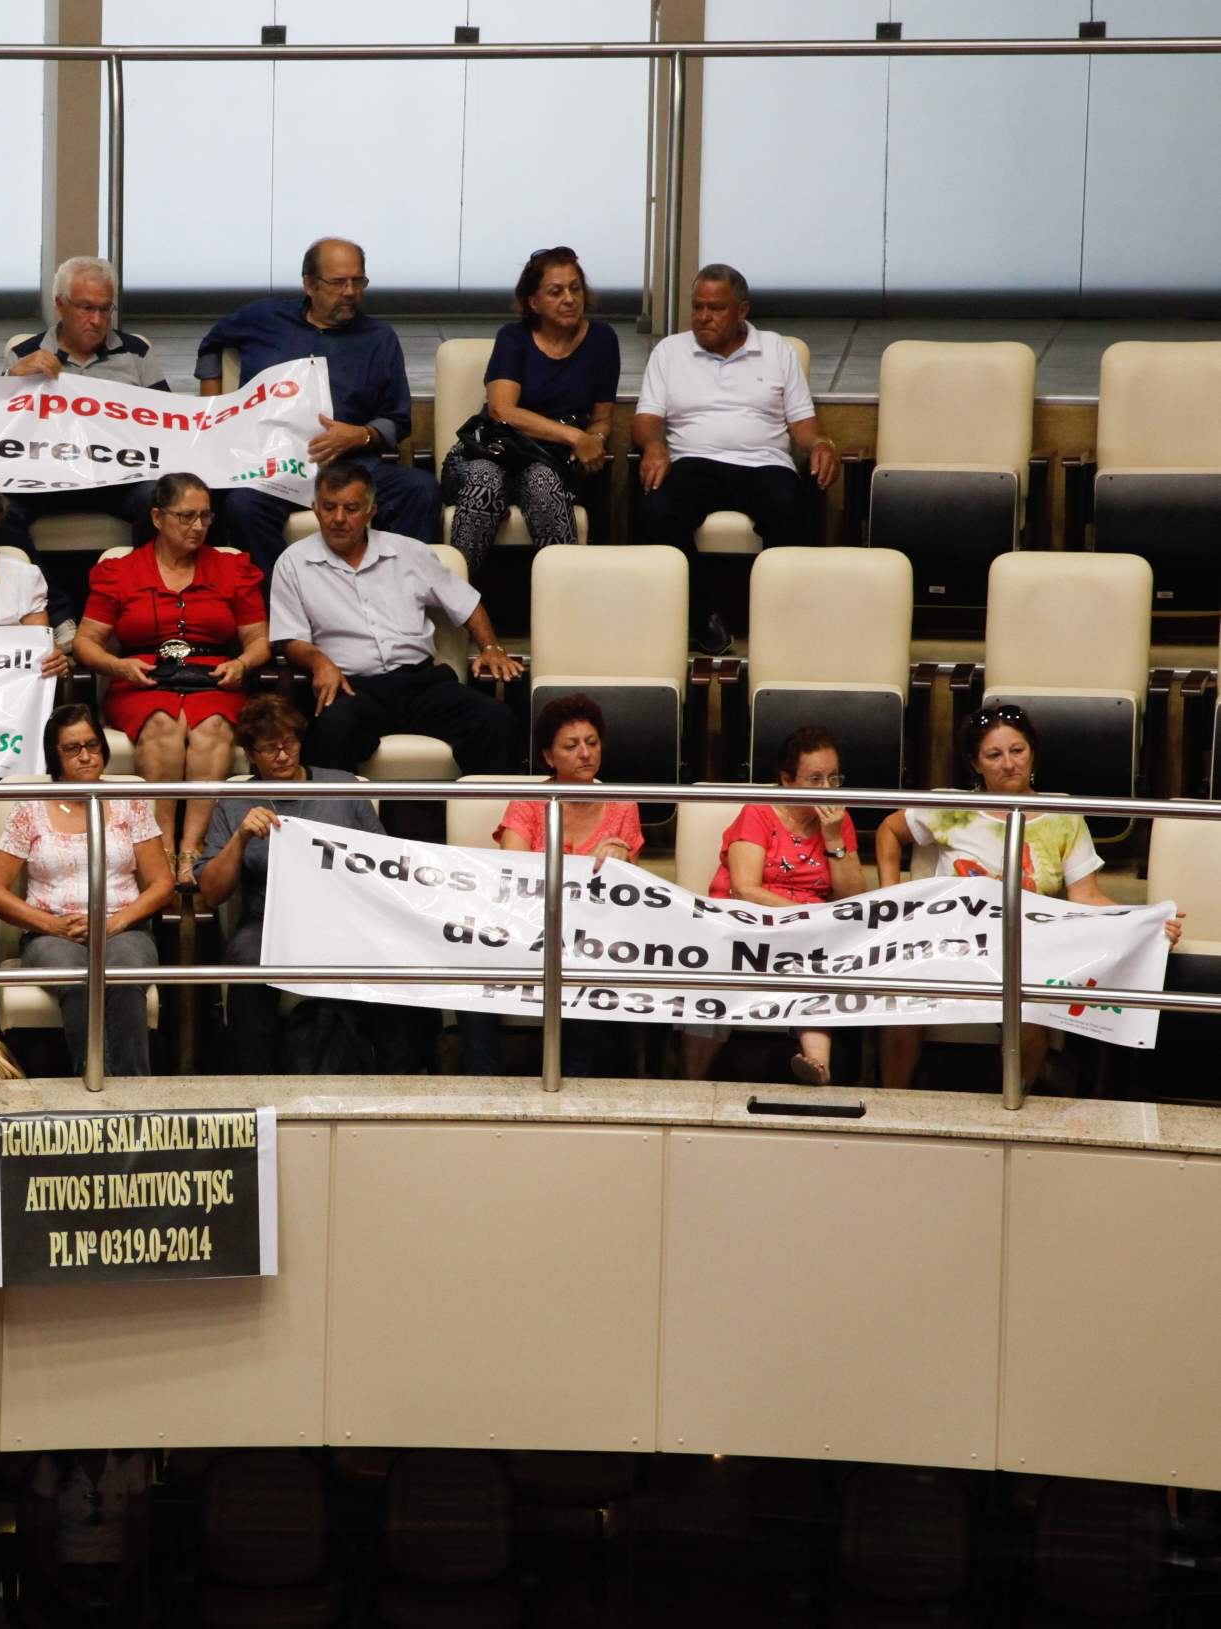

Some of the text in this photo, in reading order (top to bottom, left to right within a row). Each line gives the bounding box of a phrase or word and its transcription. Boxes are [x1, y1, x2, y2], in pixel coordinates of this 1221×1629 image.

[7, 380, 299, 431] aposentado
[311, 838, 477, 891] Todos
[492, 868, 671, 908] juntos
[692, 897, 811, 926] pela
[443, 915, 988, 974] do Abono Natalino!
[0, 1113, 257, 1157] IGUALDADE SALARIAL ENTRE
[25, 1169, 234, 1215] ATIVOS E INATIVOS TJSC
[49, 1231, 72, 1267] PL
[100, 1226, 212, 1265] 0319.0-2014
